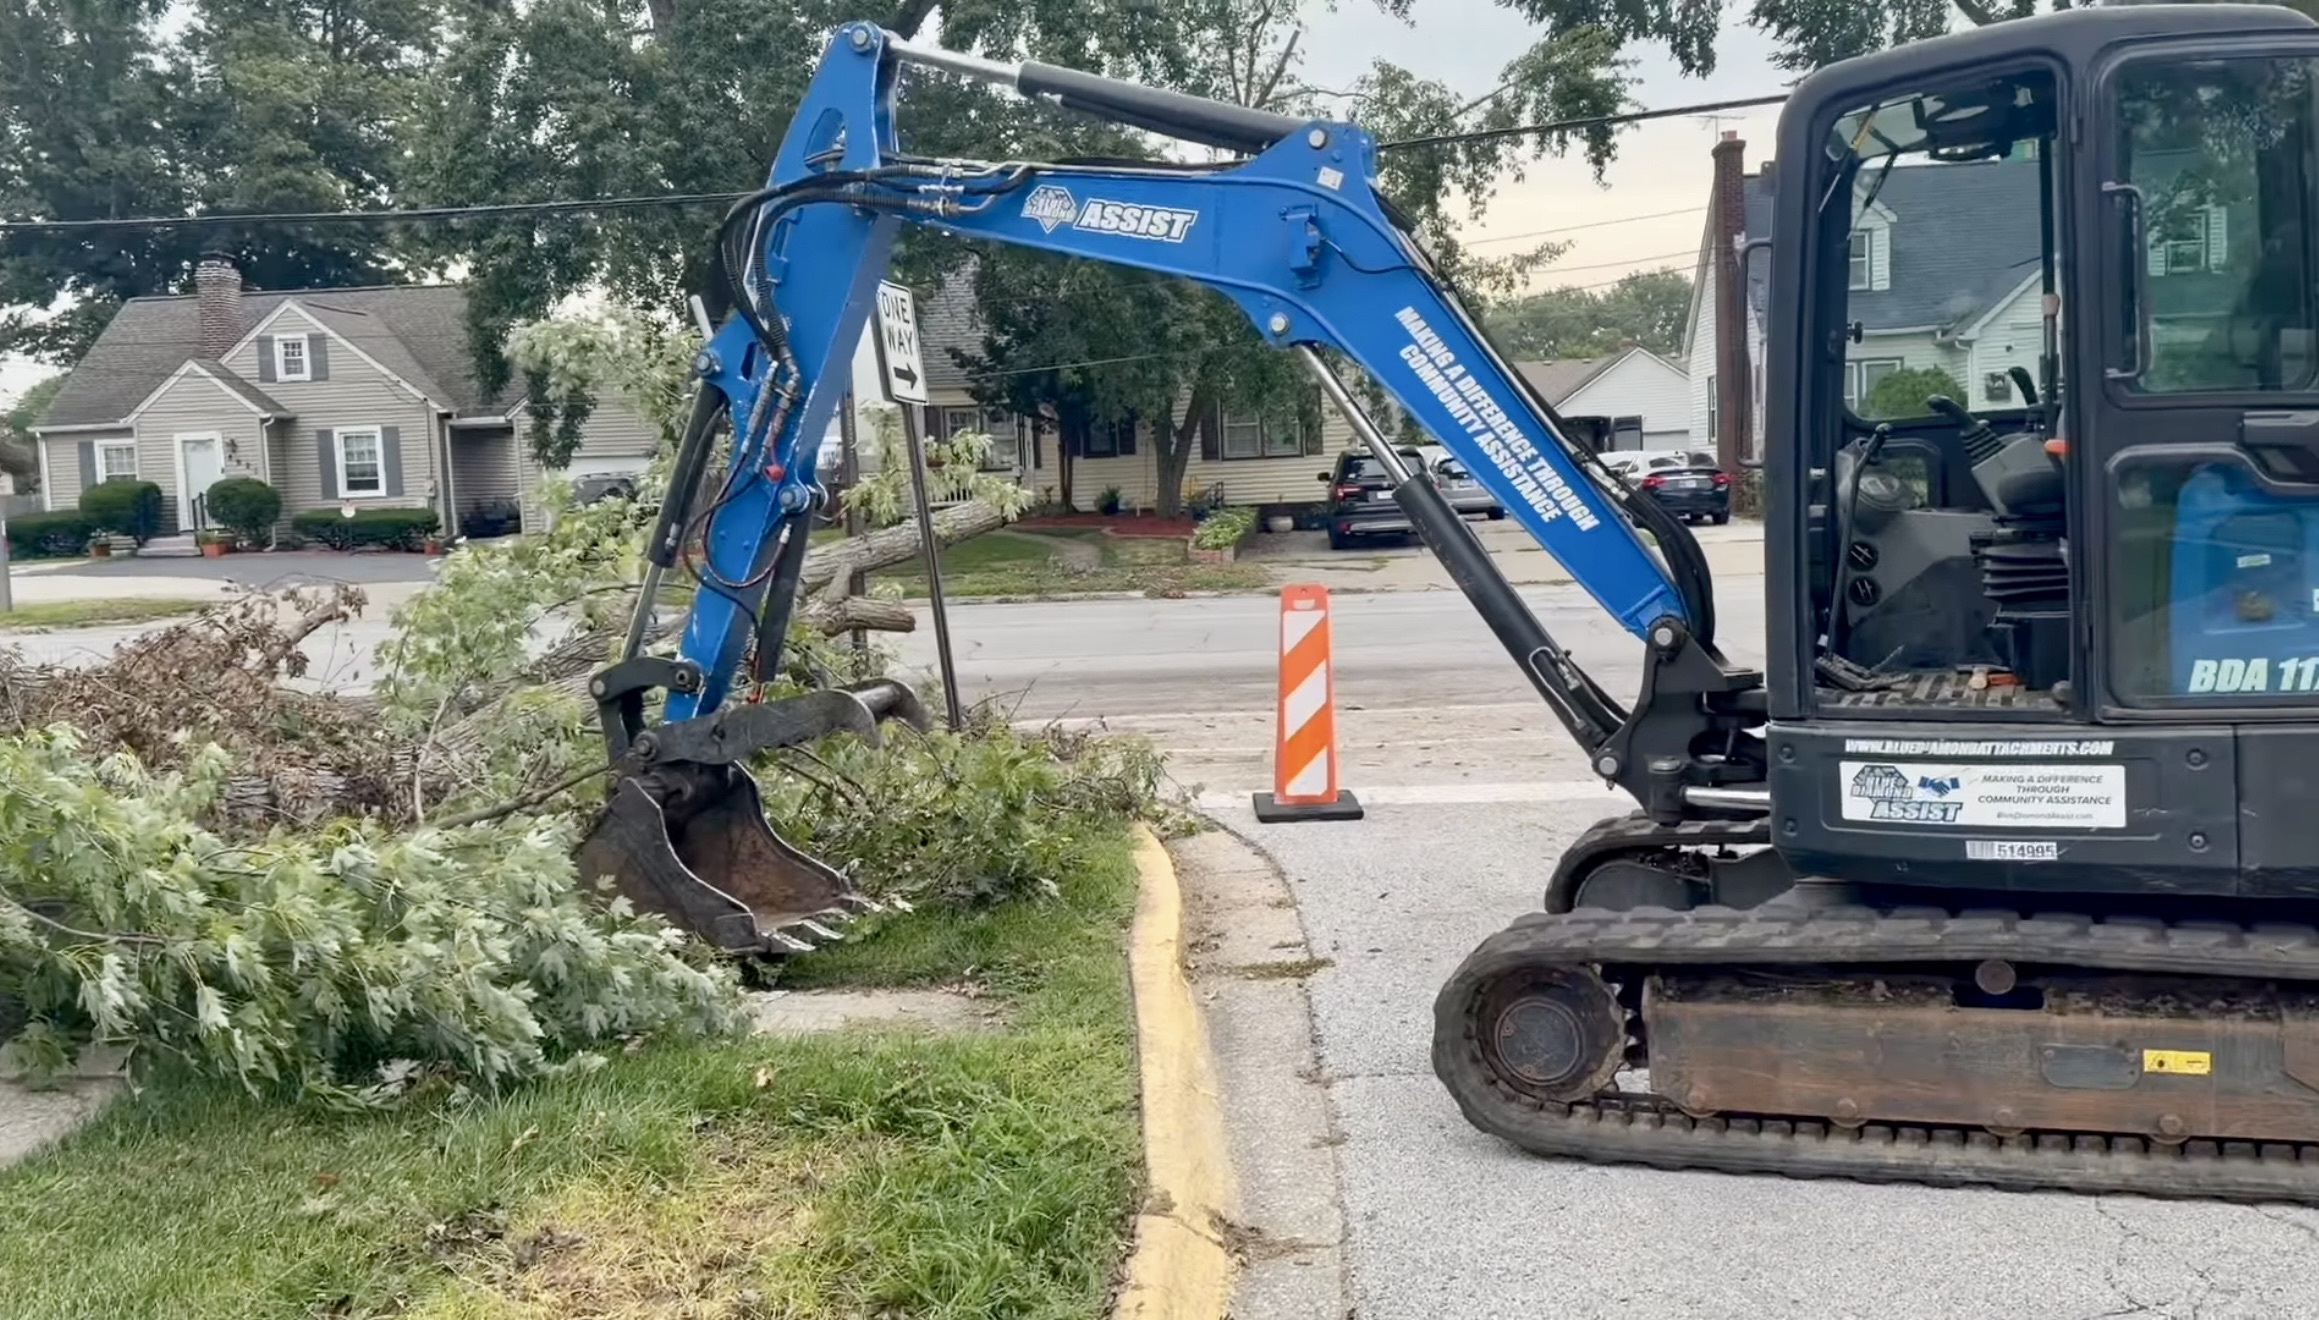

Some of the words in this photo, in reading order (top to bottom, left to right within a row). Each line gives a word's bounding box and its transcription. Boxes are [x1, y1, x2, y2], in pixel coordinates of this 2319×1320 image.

[1078, 201, 1195, 240] ASSIST
[880, 292, 909, 324] ONE
[886, 325, 912, 355] WAY
[1394, 306, 1455, 366] MAKING
[1445, 364, 1466, 382] A
[1400, 344, 1486, 434] COMMUNITY
[1474, 430, 1562, 523] ASSISTANCE
[1454, 375, 1539, 462] DIFFERENCE
[1528, 456, 1600, 531] THROUGH
[2188, 658, 2269, 692] BDA
[2278, 657, 2319, 691] 11
[1850, 784, 1914, 799] DIAMOND
[1981, 775, 2025, 784] MAKING
[2026, 776, 2035, 784] A
[2037, 775, 2103, 784] DIFFERENCE
[2017, 785, 2070, 794] THROUGH
[1871, 801, 1963, 822] ASSIST
[1978, 795, 2043, 804] COMMUNITY
[2046, 796, 2112, 805] ASSISTANCE
[1997, 844, 2056, 858] 514995
